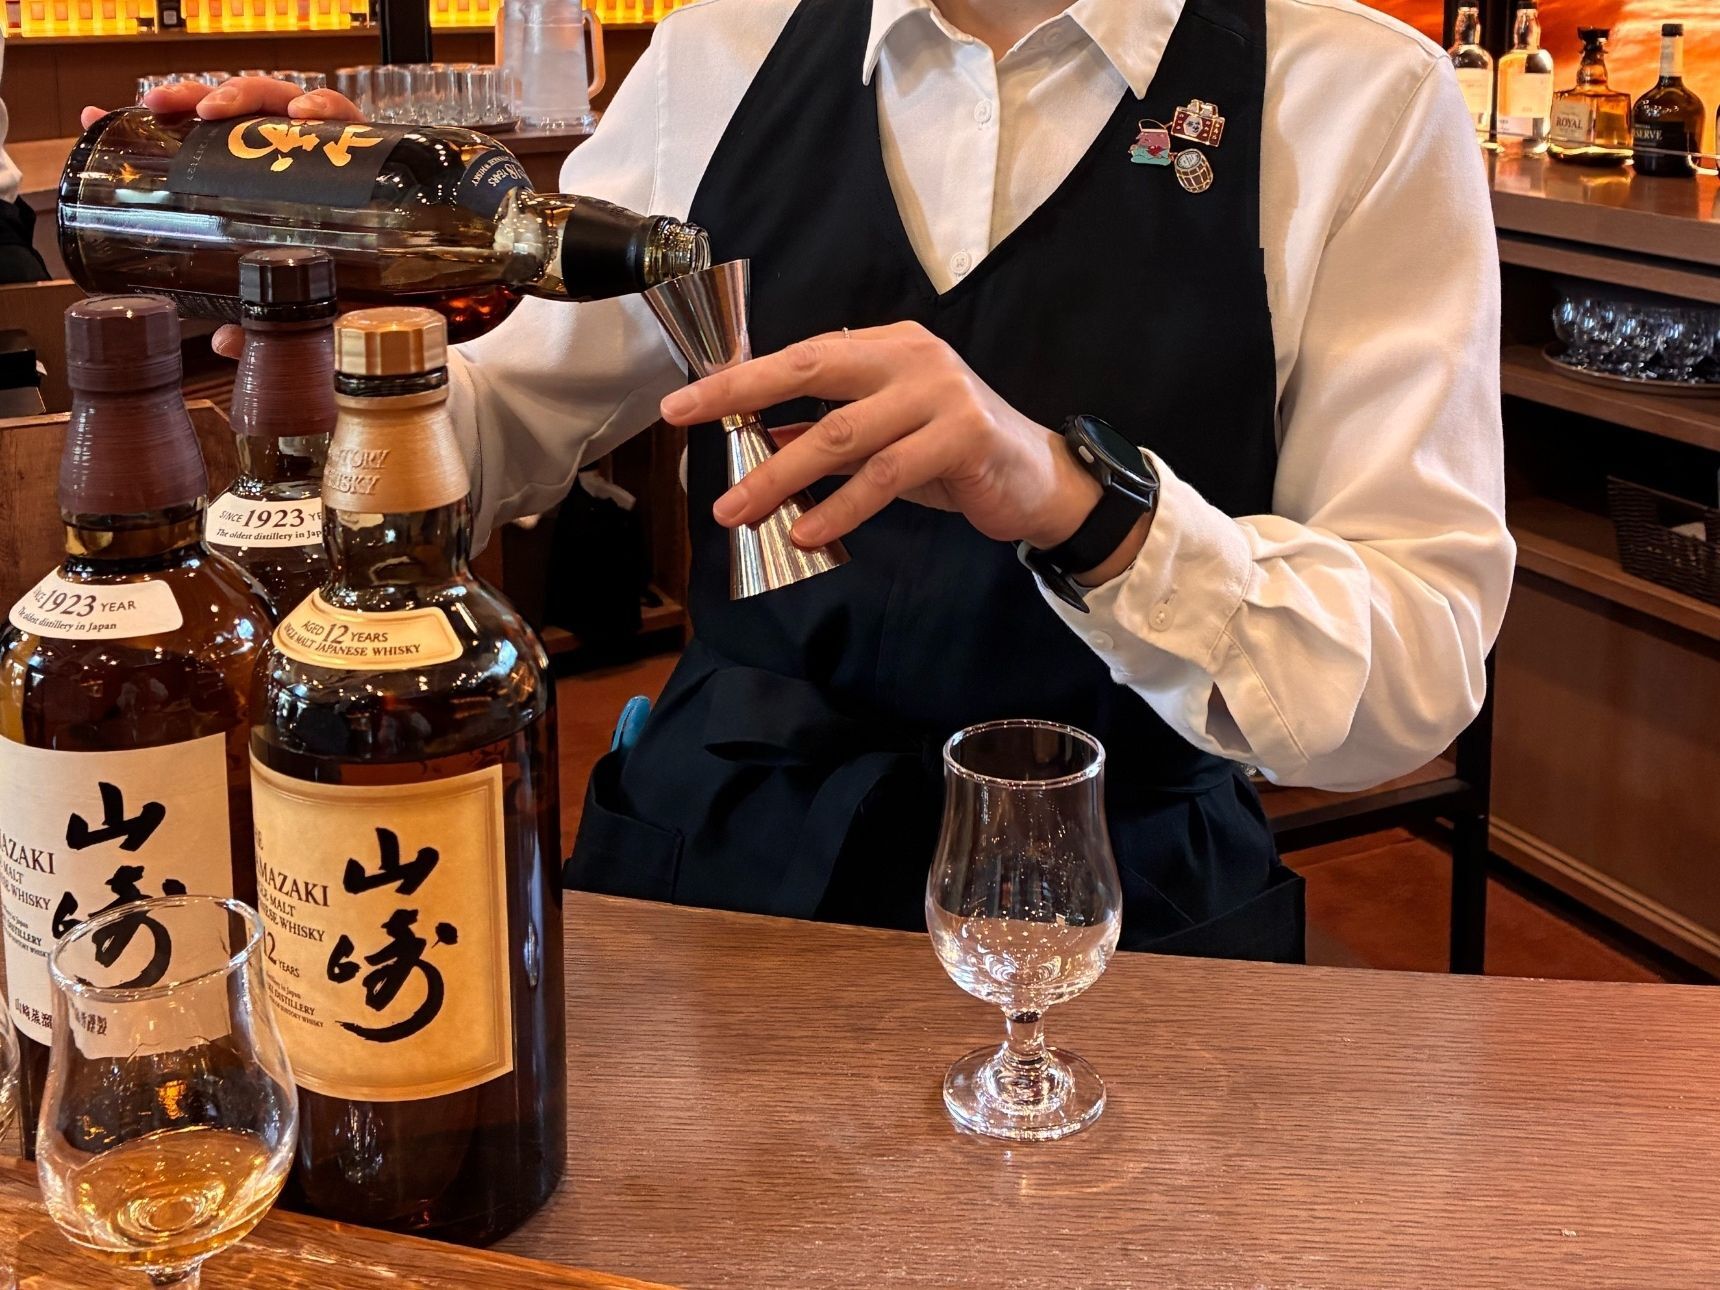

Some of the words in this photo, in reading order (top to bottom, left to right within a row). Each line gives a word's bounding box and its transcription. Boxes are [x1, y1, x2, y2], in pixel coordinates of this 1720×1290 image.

[1556, 116, 1583, 130] ROYAL
[1632, 128, 1663, 141] SERVE
[487, 168, 510, 188] YEARS
[219, 510, 244, 523] SINCE
[242, 508, 305, 529] 1923
[308, 511, 322, 521] YE
[216, 528, 229, 538] The
[229, 531, 253, 541] oldest
[253, 531, 293, 542] distillery
[295, 530, 305, 539] in
[306, 530, 322, 540] Jap
[38, 589, 97, 618] 1923
[100, 600, 137, 612] YEAR
[38, 618, 75, 633] distillery
[75, 623, 86, 631] in
[86, 621, 117, 633] Japan
[301, 620, 326, 636] AGED
[322, 623, 350, 645] 12
[350, 632, 389, 643] YEARS
[295, 635, 317, 649] MALT
[315, 642, 368, 657] JAPANESE
[372, 643, 421, 656] WHISKY
[0, 831, 56, 875] AZAKI
[52, 781, 187, 990] 山崎
[256, 855, 330, 908] MAZAKI
[10, 884, 51, 911] WHISKY
[268, 894, 296, 918] MALT
[279, 916, 326, 943] WHISKY
[326, 827, 459, 1044] 山崎
[278, 959, 300, 978] YEARS
[274, 989, 316, 1016] DISTILLERY
